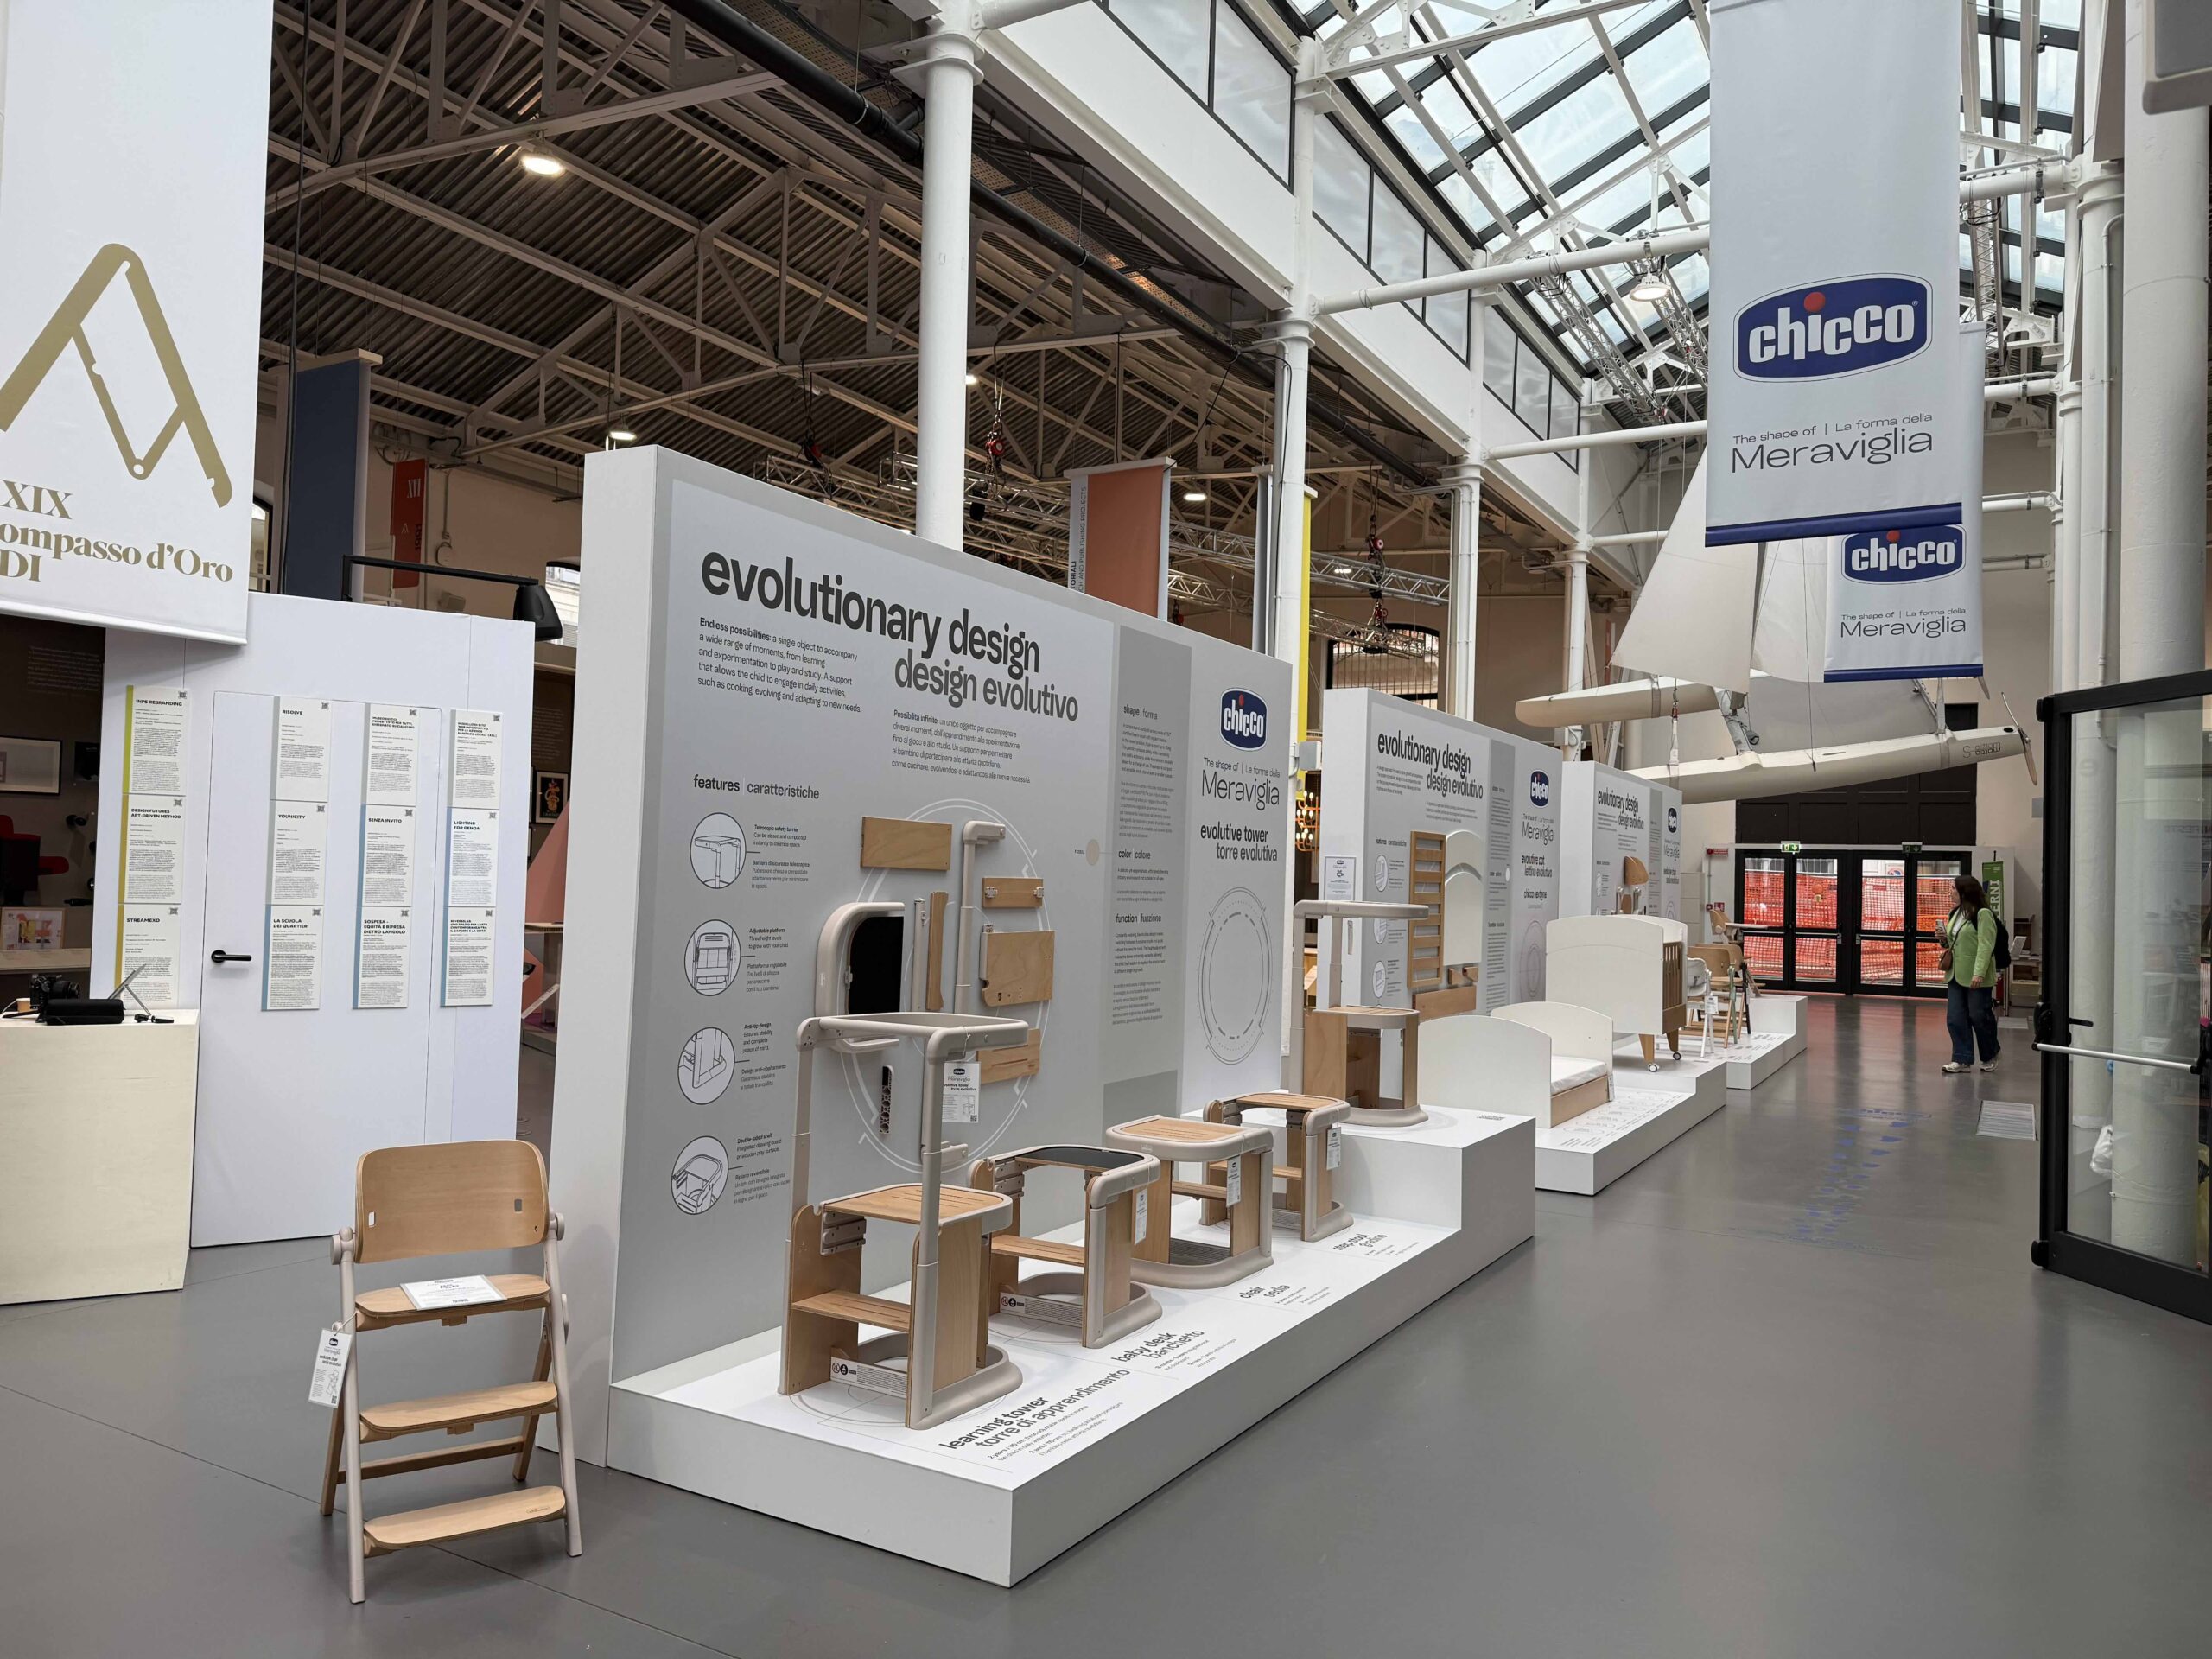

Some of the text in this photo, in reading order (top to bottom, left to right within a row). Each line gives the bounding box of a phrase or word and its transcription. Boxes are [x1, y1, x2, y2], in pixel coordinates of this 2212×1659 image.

[1749, 292, 1915, 363] chicco
[1733, 413, 1932, 444] The shape of La forma della
[1732, 428, 1932, 473] Meraviglia
[0, 479, 72, 520] XIX
[0, 523, 142, 565] ompasso
[1852, 531, 1955, 571] chicco
[0, 550, 41, 582] DI
[702, 551, 1039, 679] evolutionary design
[1841, 616, 1966, 638] Meraviglia
[699, 617, 729, 632] Endless
[729, 626, 772, 641] possibilities:
[778, 636, 796, 648] single
[796, 639, 816, 652] object
[817, 645, 823, 653] to
[823, 647, 858, 662] accompany
[705, 634, 723, 645] wide
[723, 639, 744, 651] range
[744, 642, 752, 652] of
[785, 650, 801, 662] from
[802, 653, 826, 669] learning
[698, 648, 713, 658] and
[713, 652, 768, 668] experimentation
[769, 662, 777, 671] to
[777, 663, 791, 675] play
[791, 667, 804, 676] and
[823, 671, 829, 681] A
[829, 675, 852, 685] support
[698, 662, 714, 672] that
[714, 664, 736, 677] allows
[737, 669, 749, 679] the
[749, 671, 766, 683] child
[766, 675, 774, 683] to
[774, 677, 798, 690] engage
[804, 682, 819, 694] daily
[697, 677, 715, 687] such
[716, 681, 726, 690] as
[754, 688, 782, 701] evolving
[781, 692, 795, 702] and
[795, 695, 822, 707] adapting
[822, 699, 829, 708] to
[894, 649, 1078, 721] design evolutivo
[1123, 704, 1158, 720] shape forma
[1224, 694, 1263, 737] chicco
[1204, 758, 1213, 767] The
[1216, 760, 1231, 771] shape
[1233, 762, 1239, 772] of
[1253, 766, 1268, 776] forma
[1270, 768, 1280, 778] della
[1378, 730, 1471, 779] evolutionary design
[693, 774, 820, 799] features caratteristiche
[1202, 770, 1279, 810] Meraviglia
[1427, 768, 1451, 797] design
[1452, 777, 1483, 798] evolutivo
[1598, 787, 1639, 816] evolutionary design
[1200, 822, 1268, 843] evolutive tower
[1522, 822, 1554, 845] Meraviglia
[1118, 849, 1151, 860] color colore
[1216, 842, 1278, 861] torre evolutiva
[1521, 852, 1539, 866] evolutive
[1990, 880, 2000, 919] ERNI
[1116, 913, 1162, 924] function funzione
[1332, 1239, 1357, 1251] step
[1239, 1285, 1266, 1299] chair
[1263, 1284, 1292, 1298] sedia
[1110, 1332, 1177, 1363] baby desk
[1142, 1330, 1205, 1359] banchetto
[938, 1415, 1014, 1450] learning
[1004, 1396, 1050, 1421] tower
[975, 1427, 1020, 1448] torre
[1018, 1413, 1038, 1428] di
[1032, 1369, 1131, 1421] apprendimento
